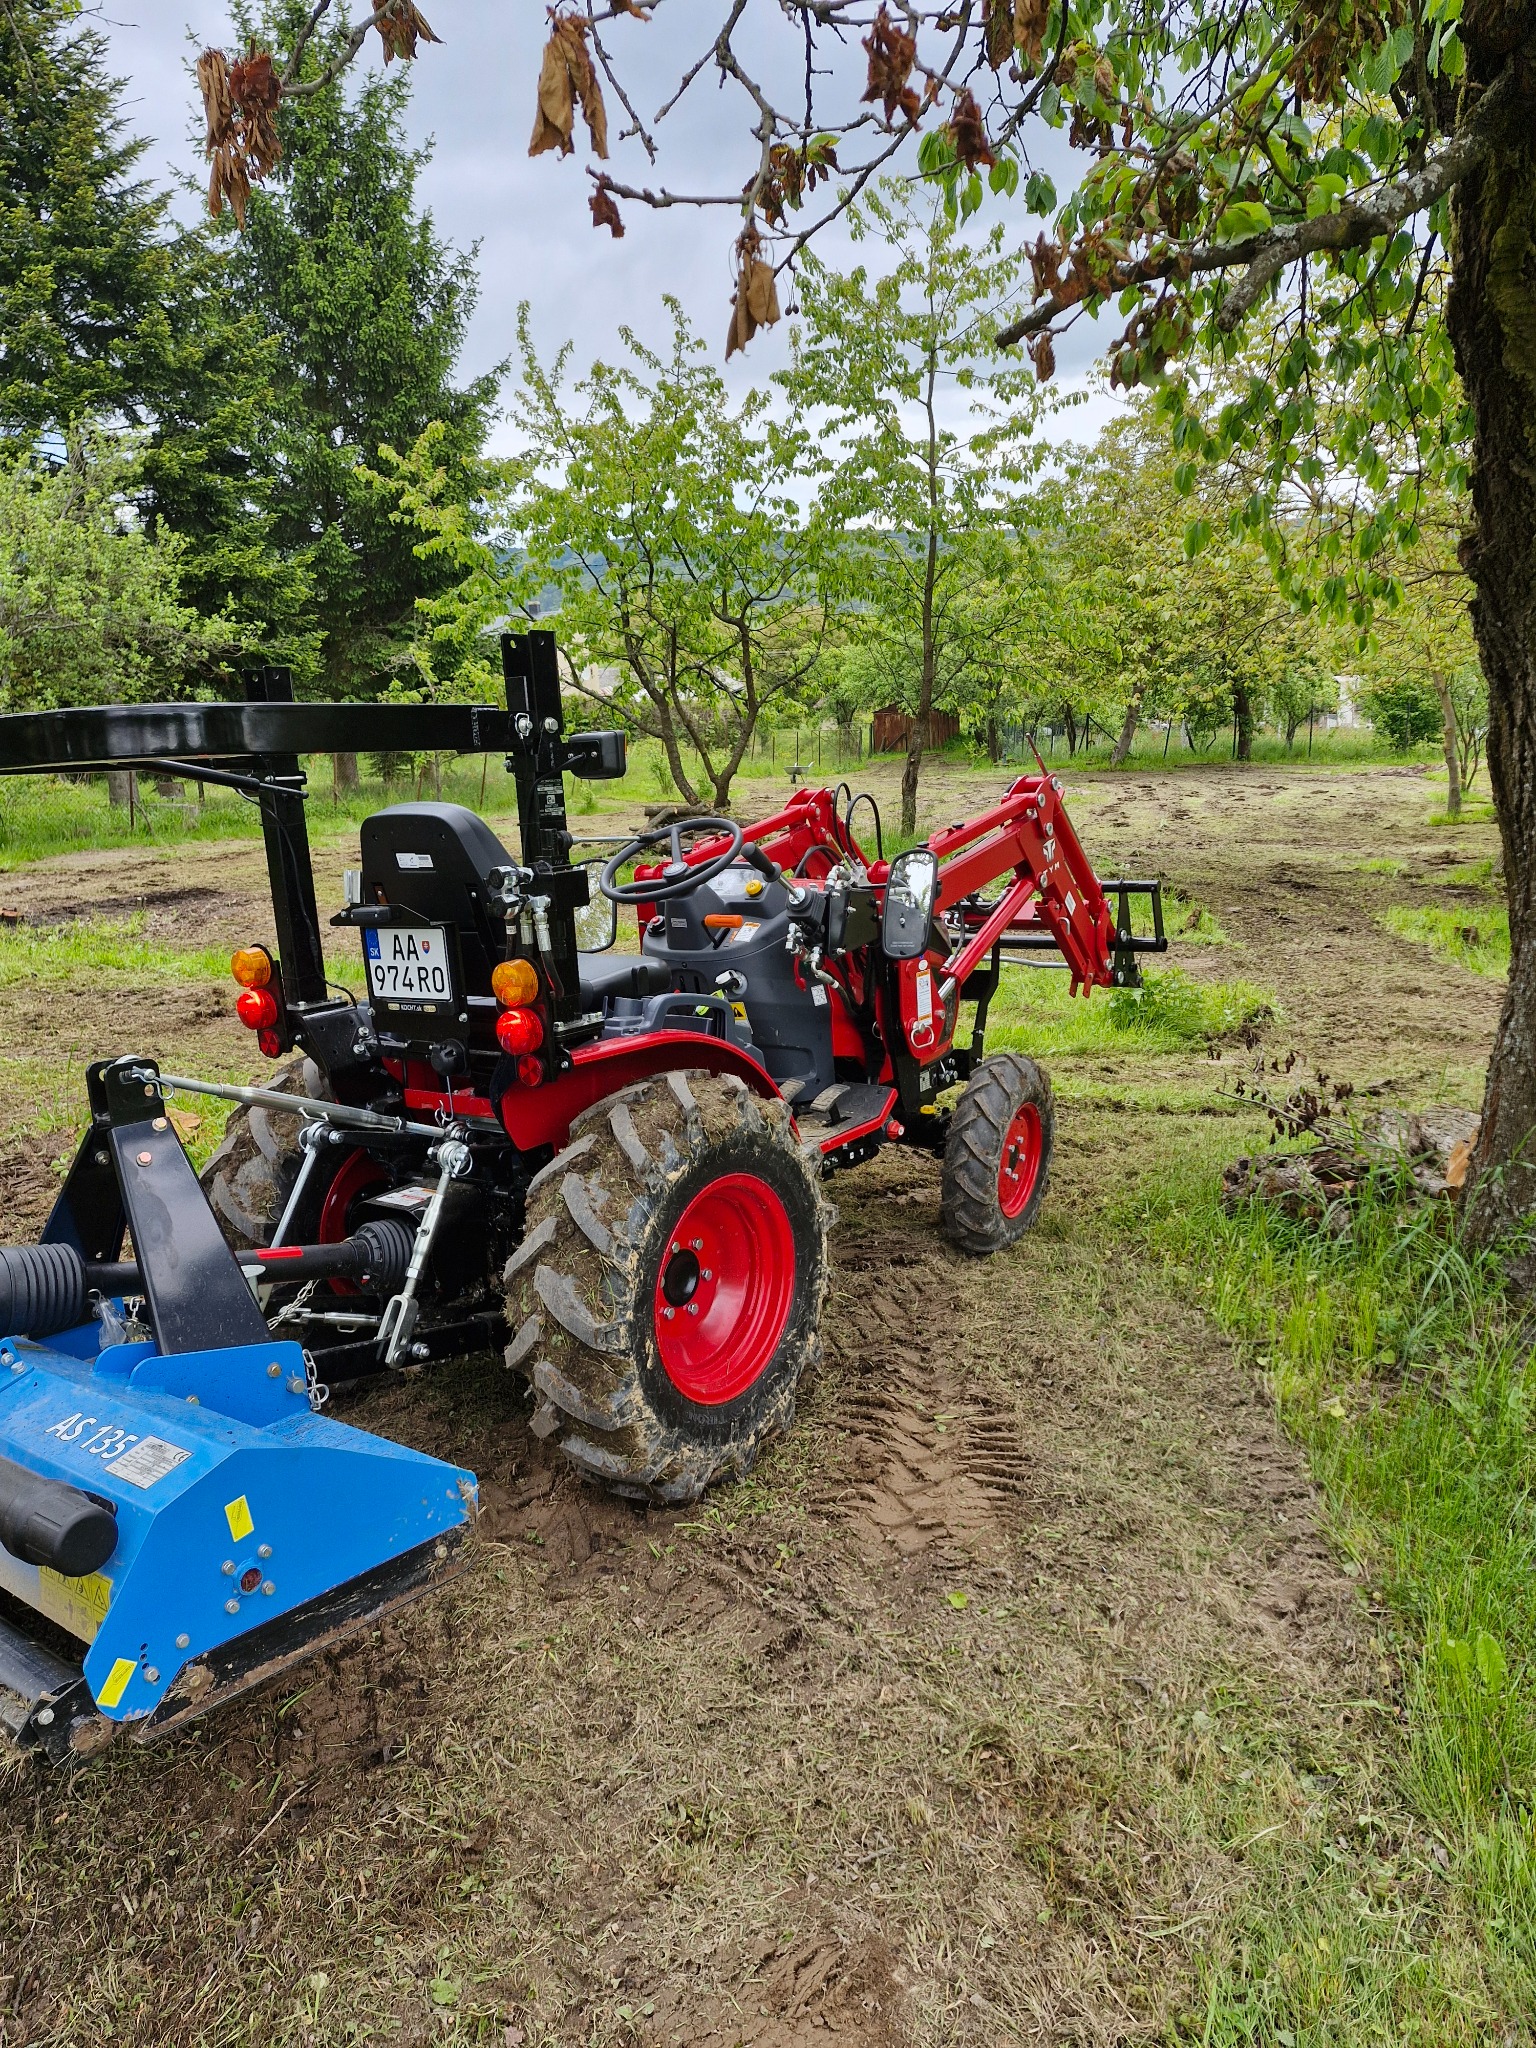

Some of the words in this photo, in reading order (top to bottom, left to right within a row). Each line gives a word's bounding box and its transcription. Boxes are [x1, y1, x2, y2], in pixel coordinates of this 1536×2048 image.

[1043, 861, 1060, 877] TYM
[370, 947, 379, 957] SK
[393, 934, 420, 961] AA
[45, 1412, 98, 1441] AS
[80, 1425, 139, 1459] 135
